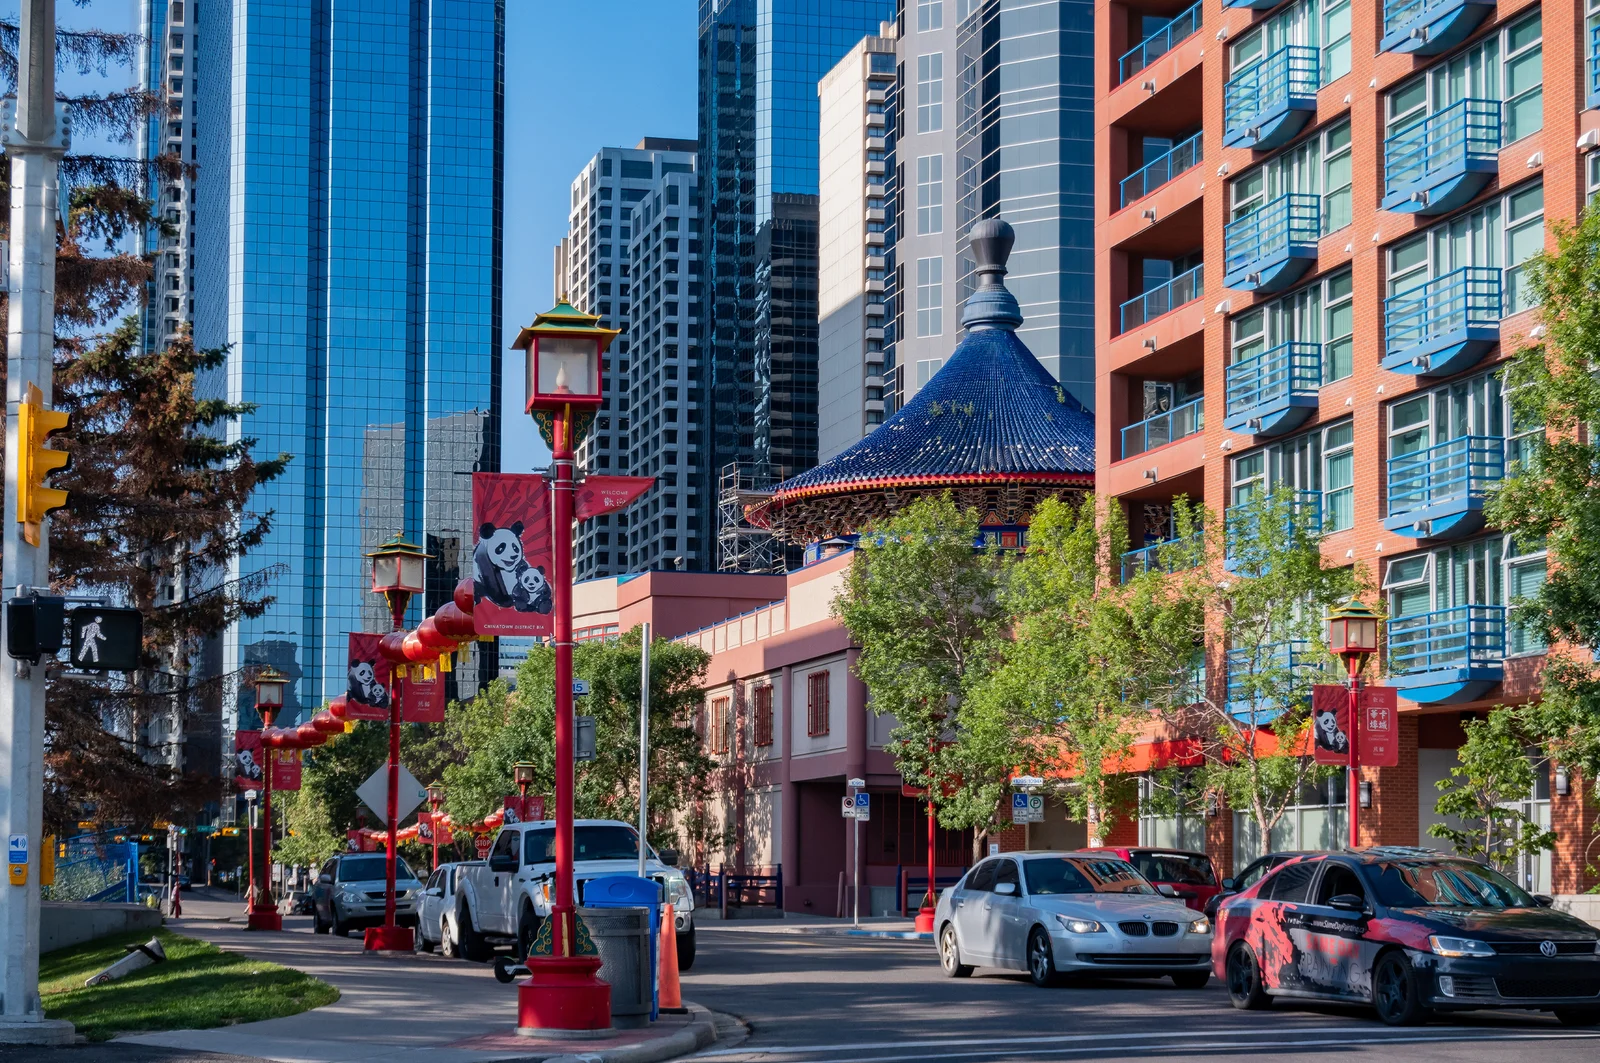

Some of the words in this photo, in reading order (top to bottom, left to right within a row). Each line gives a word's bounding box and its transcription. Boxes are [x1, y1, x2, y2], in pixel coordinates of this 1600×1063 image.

[476, 839, 491, 847] STOP
[1306, 933, 1336, 955] SAME
[1337, 939, 1361, 960] DAY
